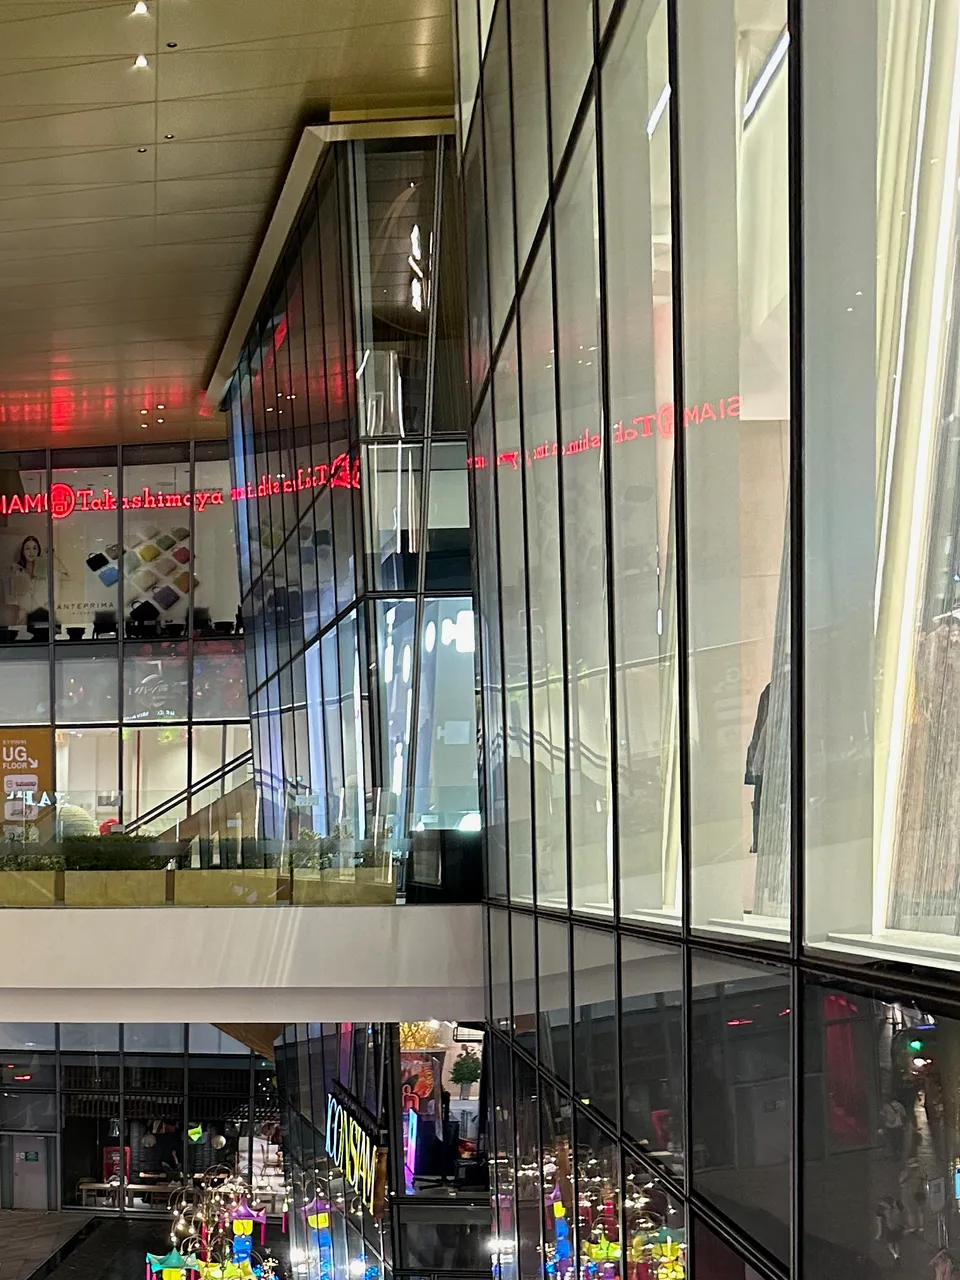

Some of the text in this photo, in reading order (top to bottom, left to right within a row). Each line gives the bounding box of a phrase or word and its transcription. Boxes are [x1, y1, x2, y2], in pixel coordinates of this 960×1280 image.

[56, 602, 114, 610] ANTEPRIMA
[2, 746, 28, 762] UG
[325, 1093, 378, 1216] ICONSIAM
